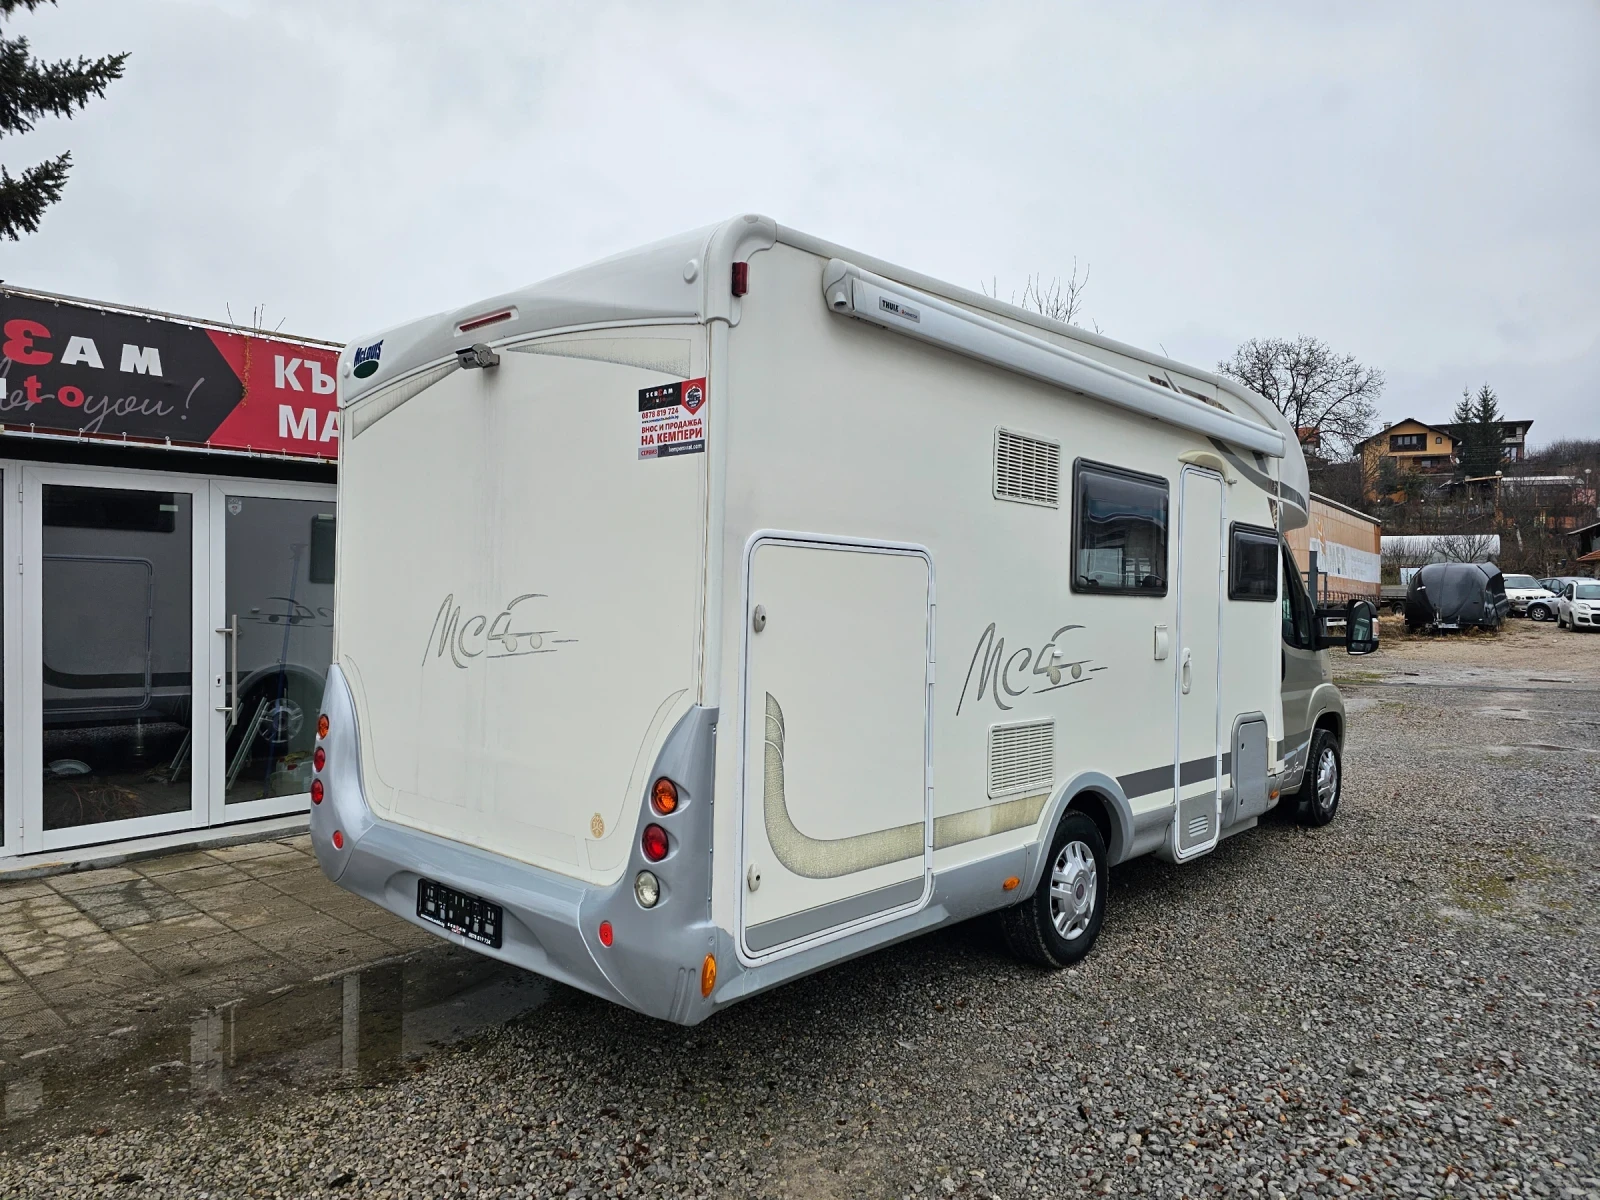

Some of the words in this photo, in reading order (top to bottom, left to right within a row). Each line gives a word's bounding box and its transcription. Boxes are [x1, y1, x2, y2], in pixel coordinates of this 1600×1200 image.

[882, 300, 899, 313] THULE
[642, 411, 655, 419] 0878
[656, 409, 667, 417] 819
[668, 407, 679, 415] 724
[642, 425, 658, 434] ВНОС
[659, 423, 664, 431] И
[665, 418, 702, 430] ПРОДАЖБА
[641, 434, 655, 445] НА
[657, 427, 702, 444] КЕМПЕРИ
